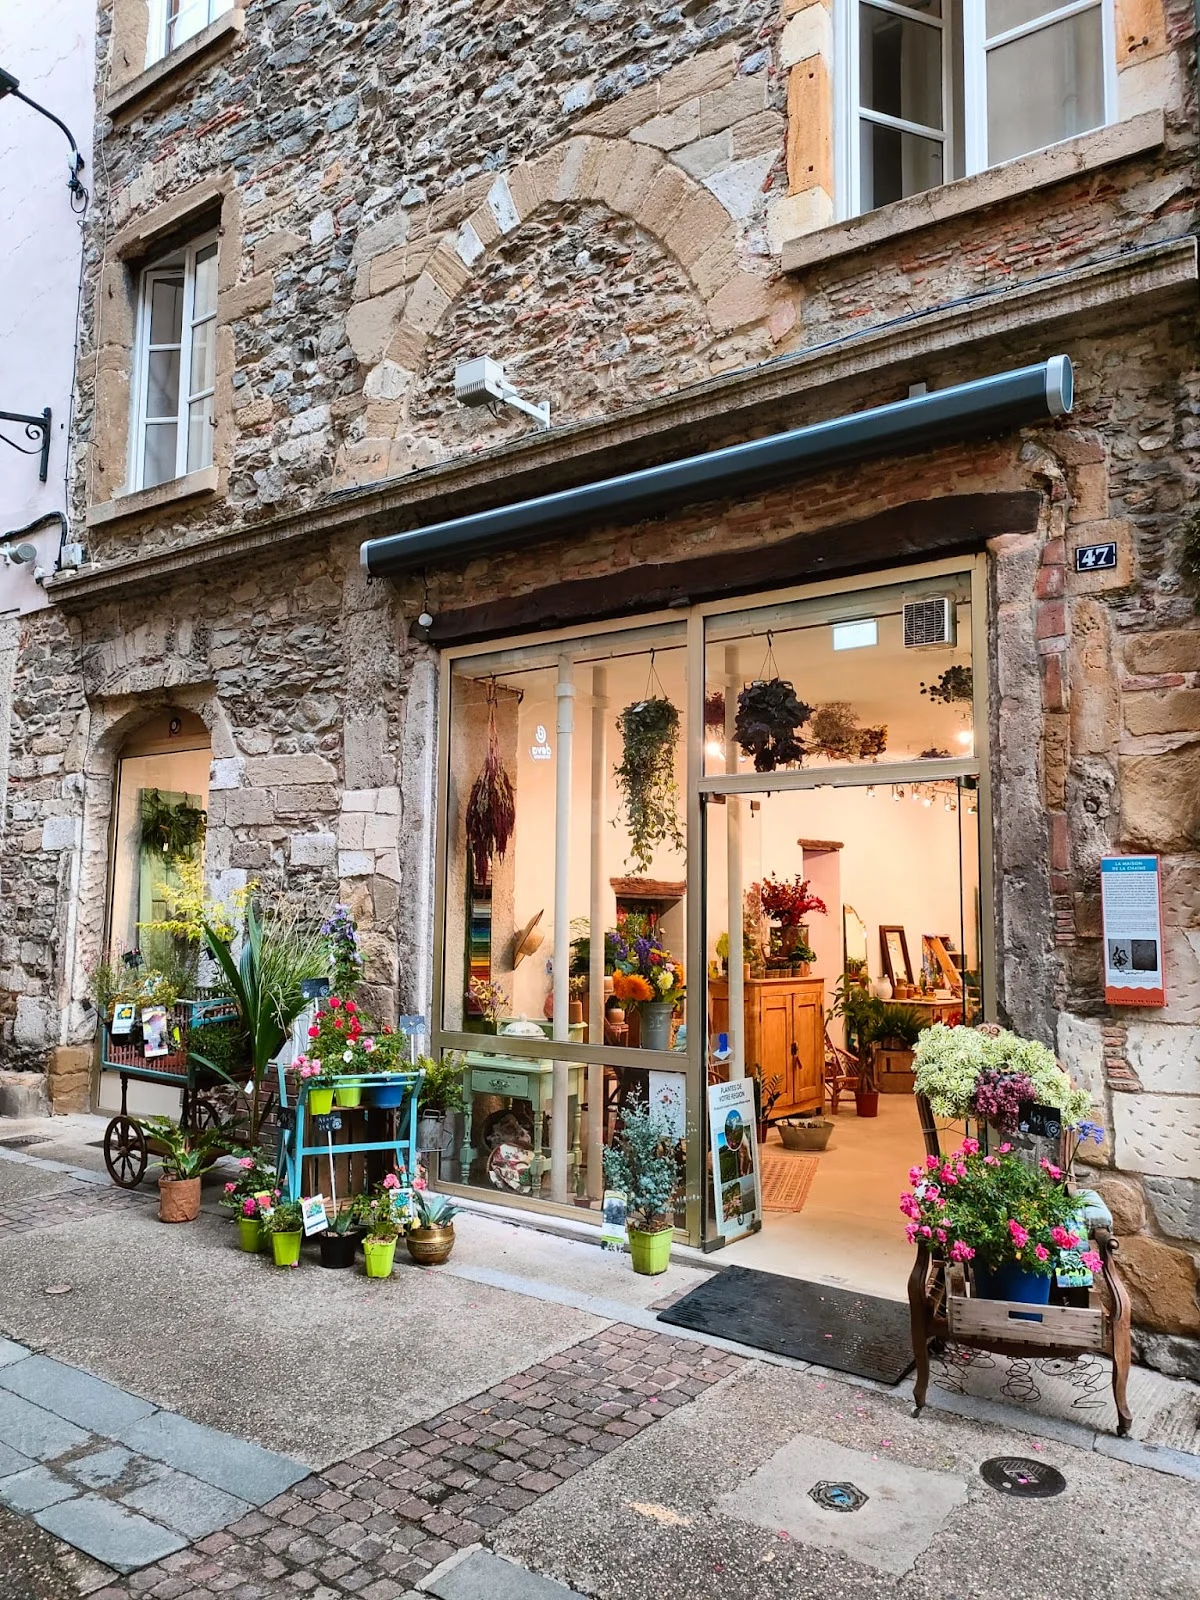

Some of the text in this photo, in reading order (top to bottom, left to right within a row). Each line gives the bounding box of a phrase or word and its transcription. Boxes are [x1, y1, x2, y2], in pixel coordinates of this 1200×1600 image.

[1081, 547, 1109, 566] 47
[720, 1084, 737, 1094] PLANTES
[718, 1094, 731, 1102] VOTRE
